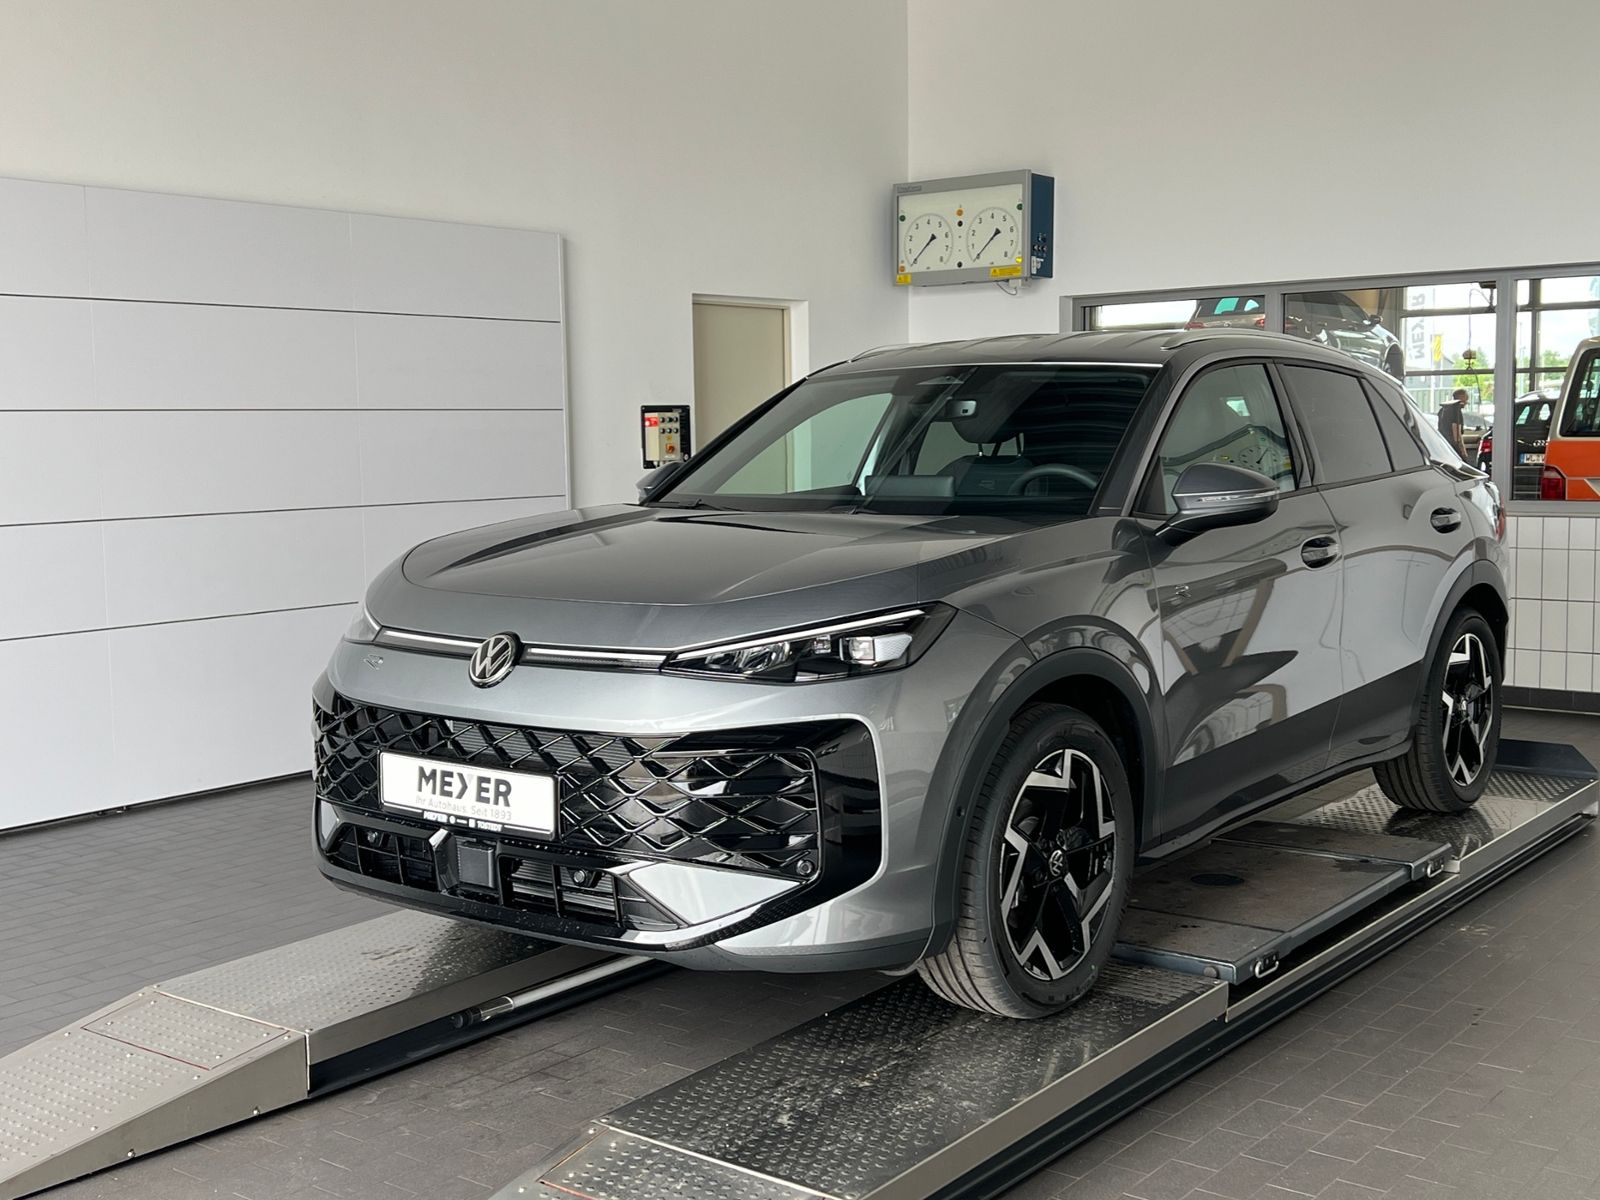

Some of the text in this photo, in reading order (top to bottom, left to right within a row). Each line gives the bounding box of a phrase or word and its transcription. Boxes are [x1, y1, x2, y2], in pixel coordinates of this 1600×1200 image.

[417, 766, 512, 807] MEYER
[471, 805, 488, 818] Seit
[490, 808, 512, 822] 1893
